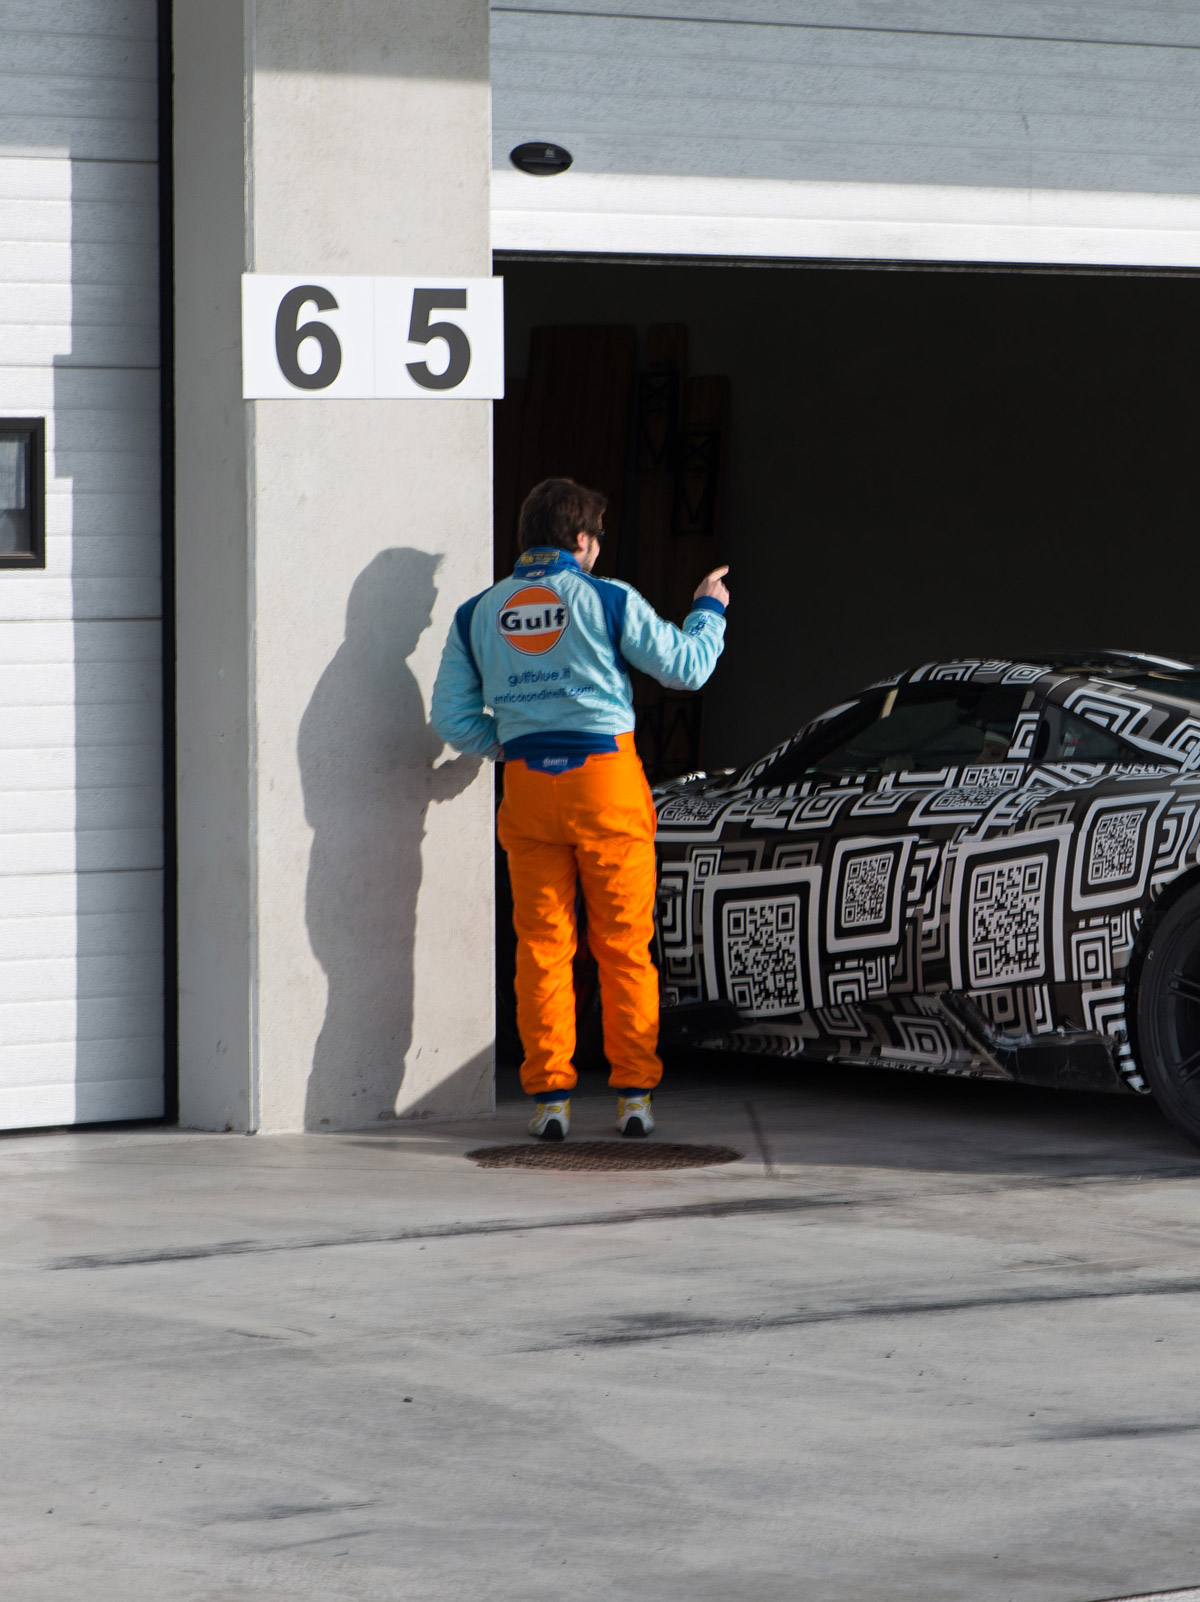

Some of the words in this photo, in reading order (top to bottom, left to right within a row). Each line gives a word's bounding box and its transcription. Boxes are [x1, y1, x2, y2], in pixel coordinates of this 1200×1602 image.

[275, 284, 342, 391] 6
[406, 287, 471, 391] 5
[500, 606, 567, 630] Gulf
[507, 666, 571, 687] gulfblue.it
